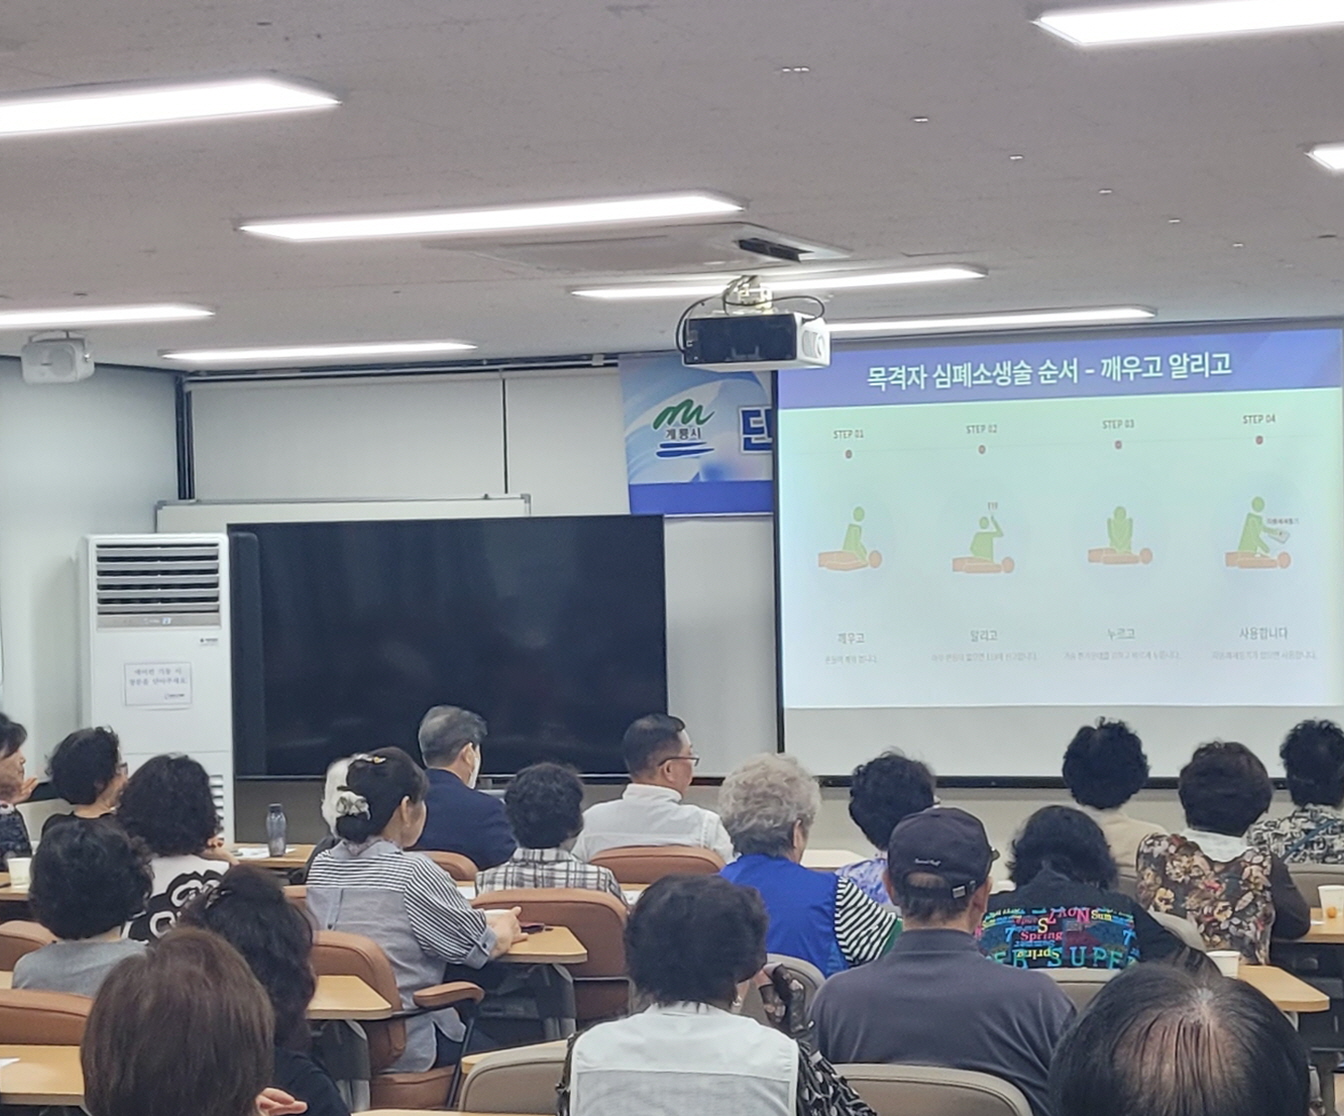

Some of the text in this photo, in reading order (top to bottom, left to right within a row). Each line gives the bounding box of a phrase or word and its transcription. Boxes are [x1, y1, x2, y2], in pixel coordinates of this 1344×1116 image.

[866, 364, 927, 391] 목격자
[932, 361, 1033, 388] 심폐소생술
[1037, 357, 1079, 384] 순서
[1100, 355, 1163, 381] 깨우고
[1169, 352, 1232, 378] 알리고
[1102, 420, 1123, 429] STEP
[1243, 415, 1263, 424] STEP
[666, 427, 702, 440] 계룡시
[966, 425, 986, 434] STEP
[833, 430, 853, 440] STEP
[1020, 931, 1063, 943] Spring
